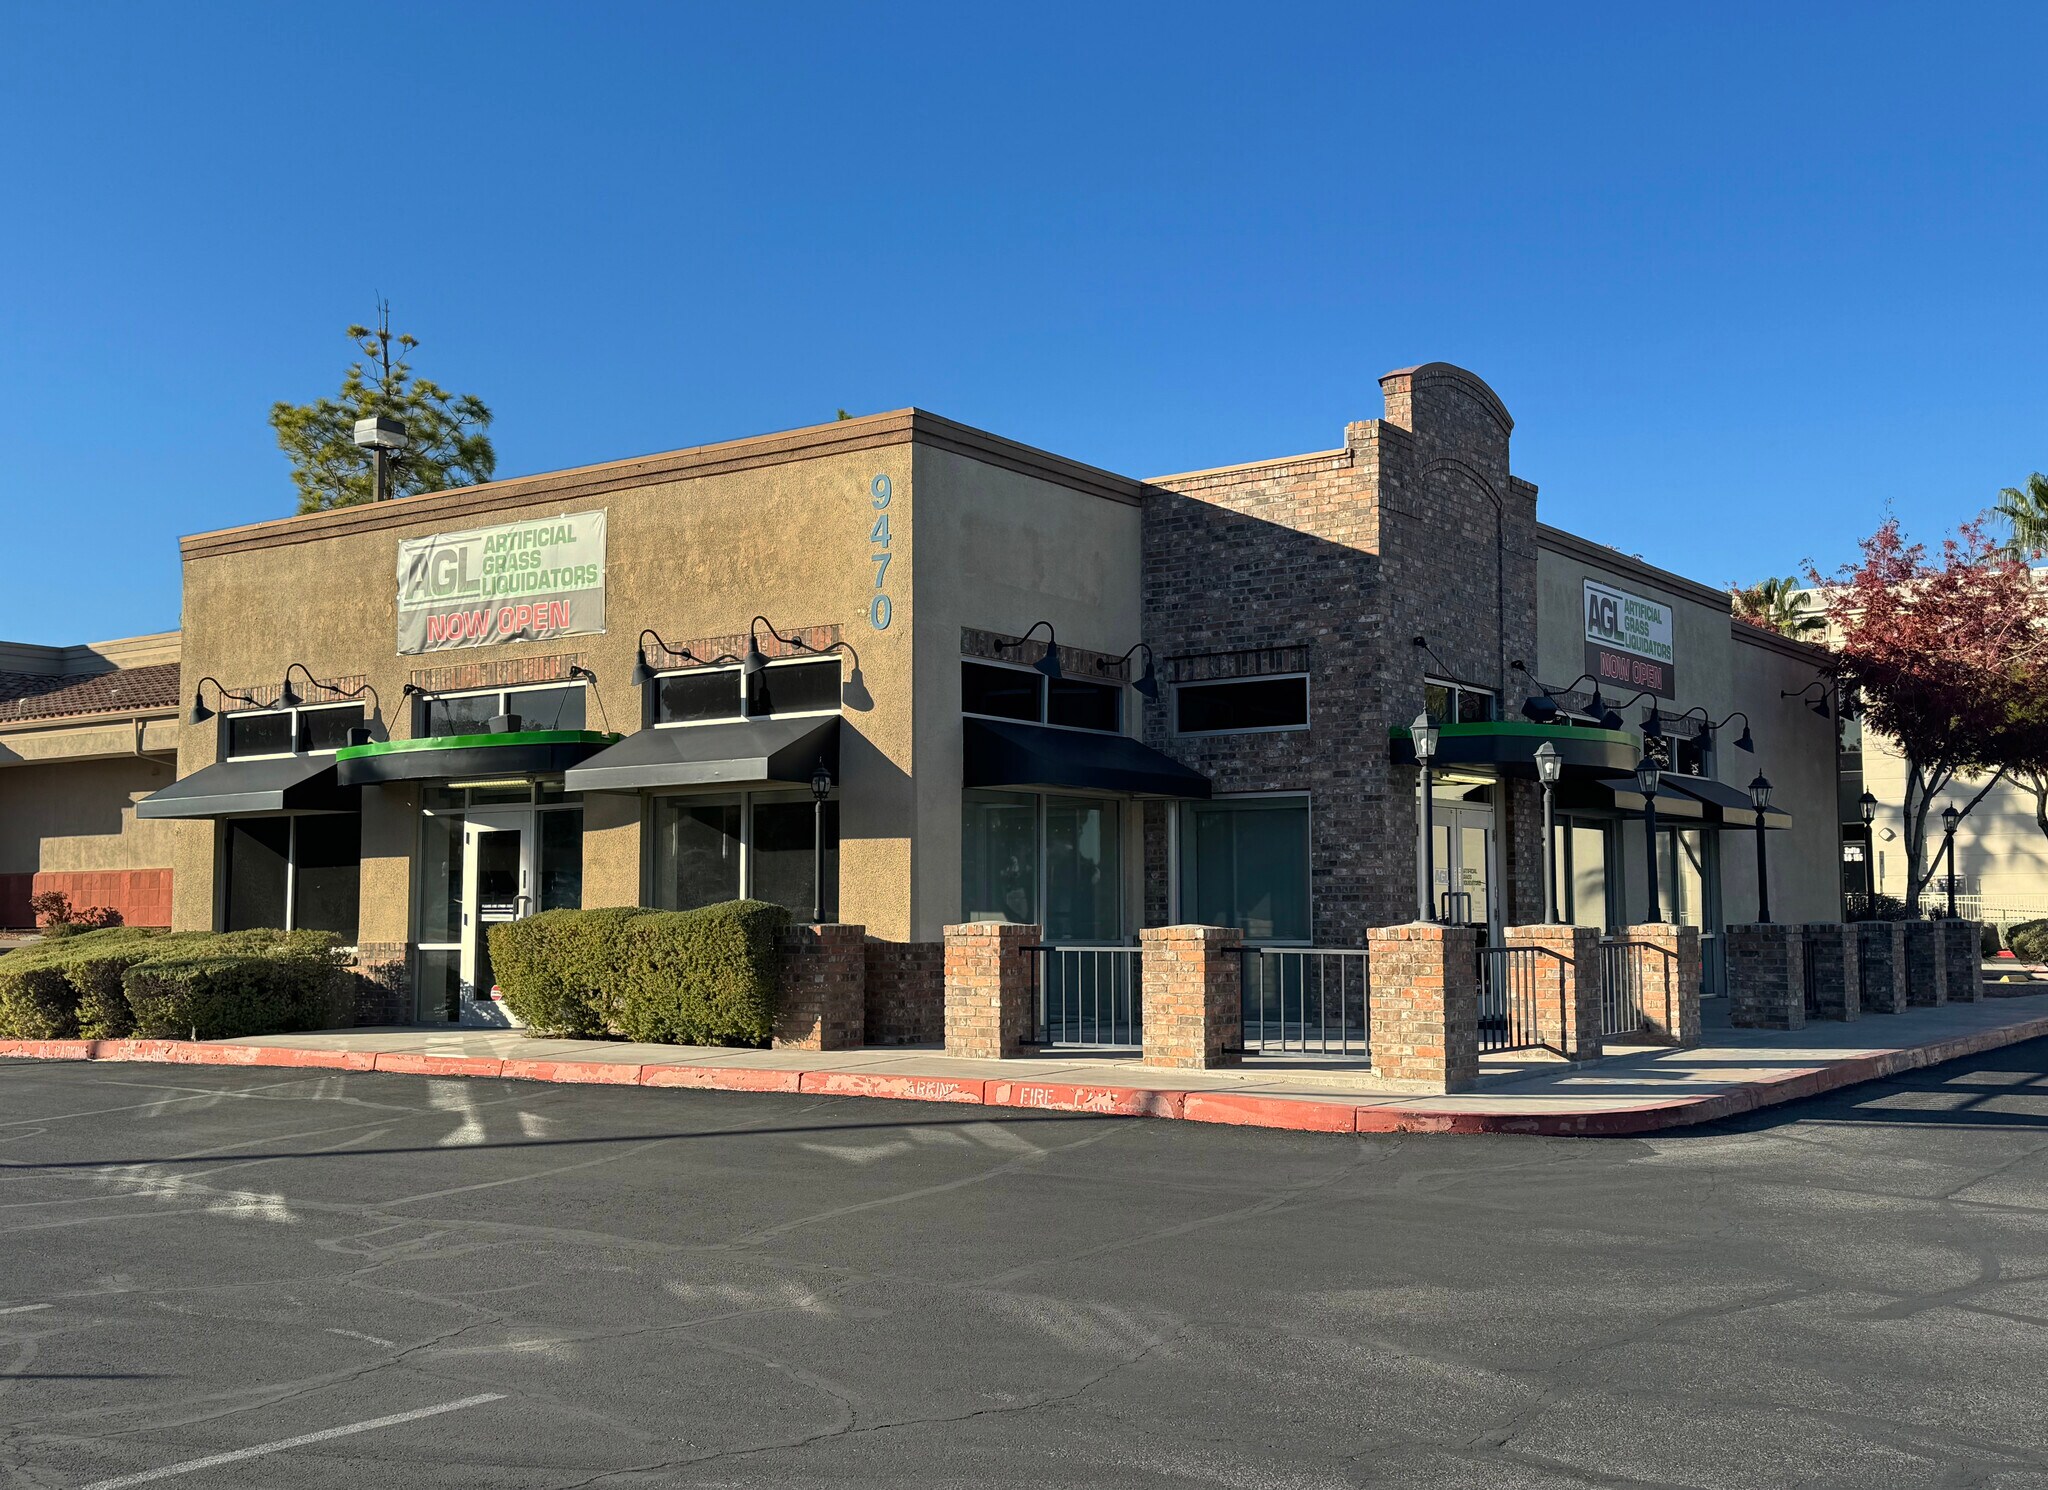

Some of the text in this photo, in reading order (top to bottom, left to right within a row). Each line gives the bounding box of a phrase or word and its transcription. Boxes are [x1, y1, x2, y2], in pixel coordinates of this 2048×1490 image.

[483, 524, 577, 555] ARTIFICIAL
[870, 473, 892, 631] 9470
[405, 546, 481, 600] AGL
[482, 549, 542, 576] GRASS
[482, 563, 598, 596] LIQUIDATORS
[427, 599, 571, 643] NOW OPEN
[1588, 594, 1624, 641] AGL
[1624, 599, 1662, 625] ARTIFICIAL
[1624, 615, 1650, 638] GRASS
[1624, 633, 1672, 660] LIQUIDATORS
[1600, 651, 1663, 690] NOW OPEN
